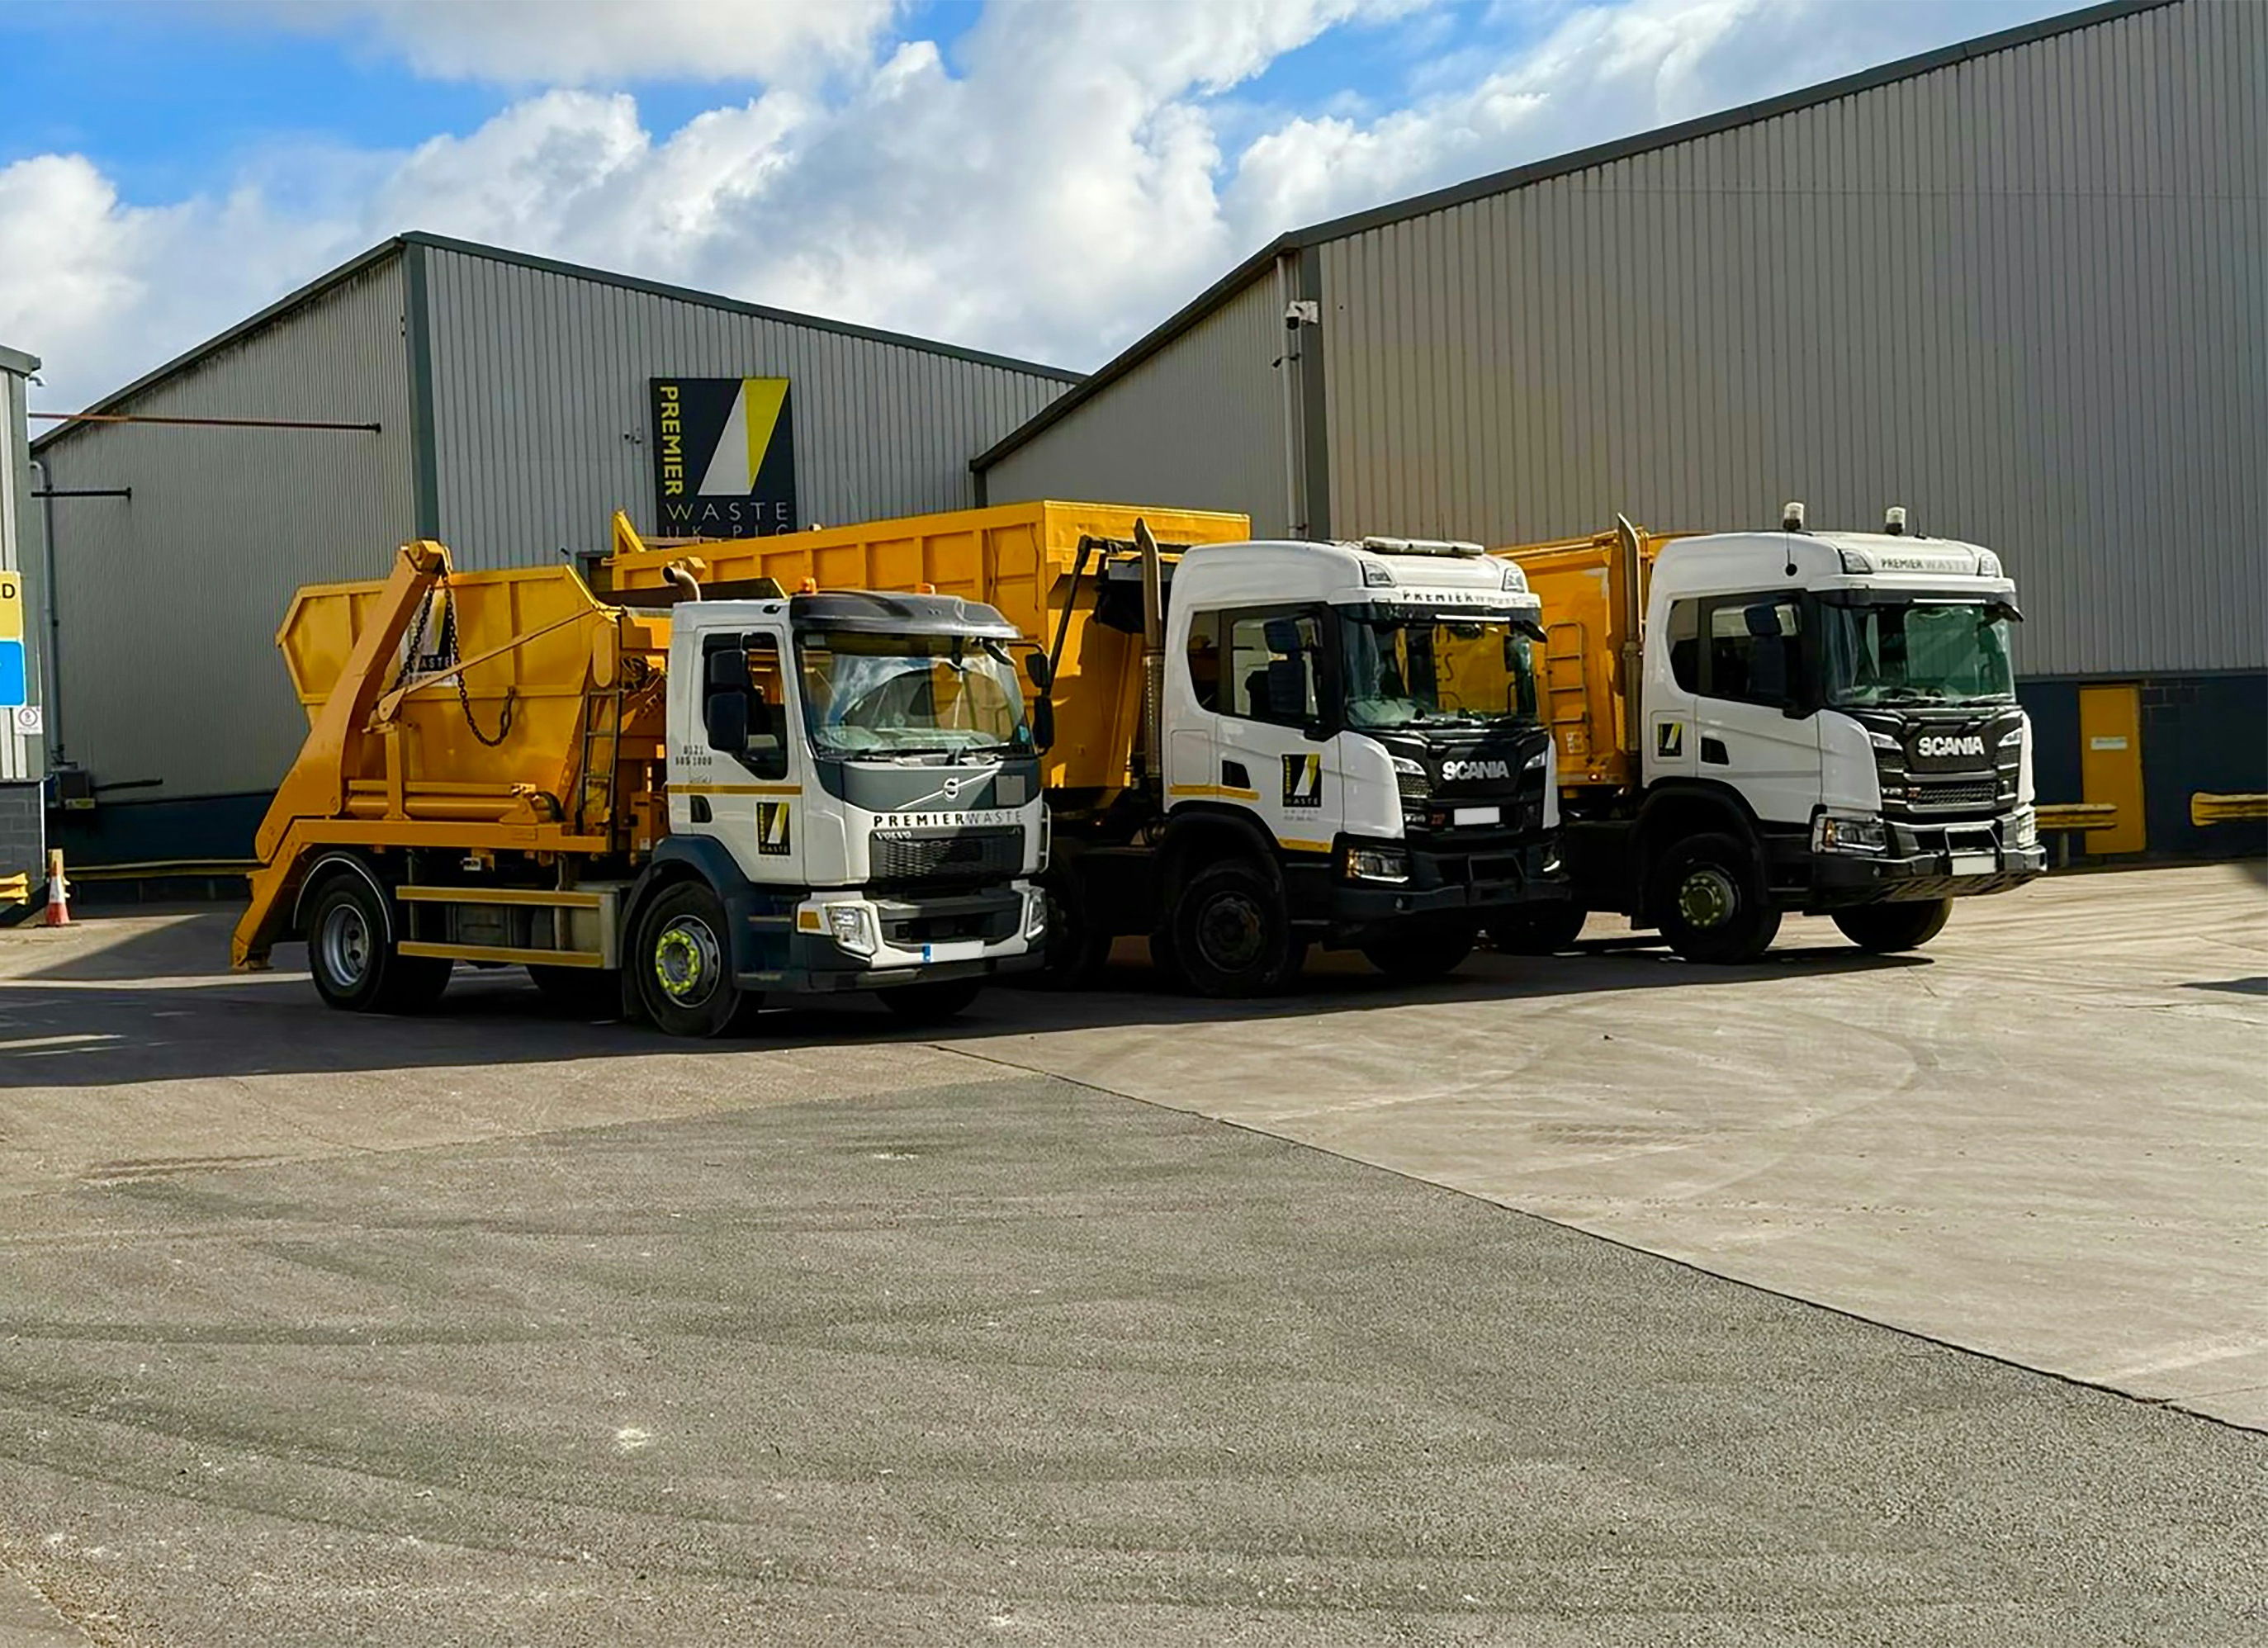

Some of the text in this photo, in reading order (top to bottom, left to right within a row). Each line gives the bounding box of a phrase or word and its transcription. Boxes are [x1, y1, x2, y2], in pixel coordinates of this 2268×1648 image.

[660, 386, 684, 496] PREMIER
[665, 501, 788, 521] WASTE
[1917, 736, 1985, 757] SCANIA
[1442, 760, 1510, 781] SCANIA
